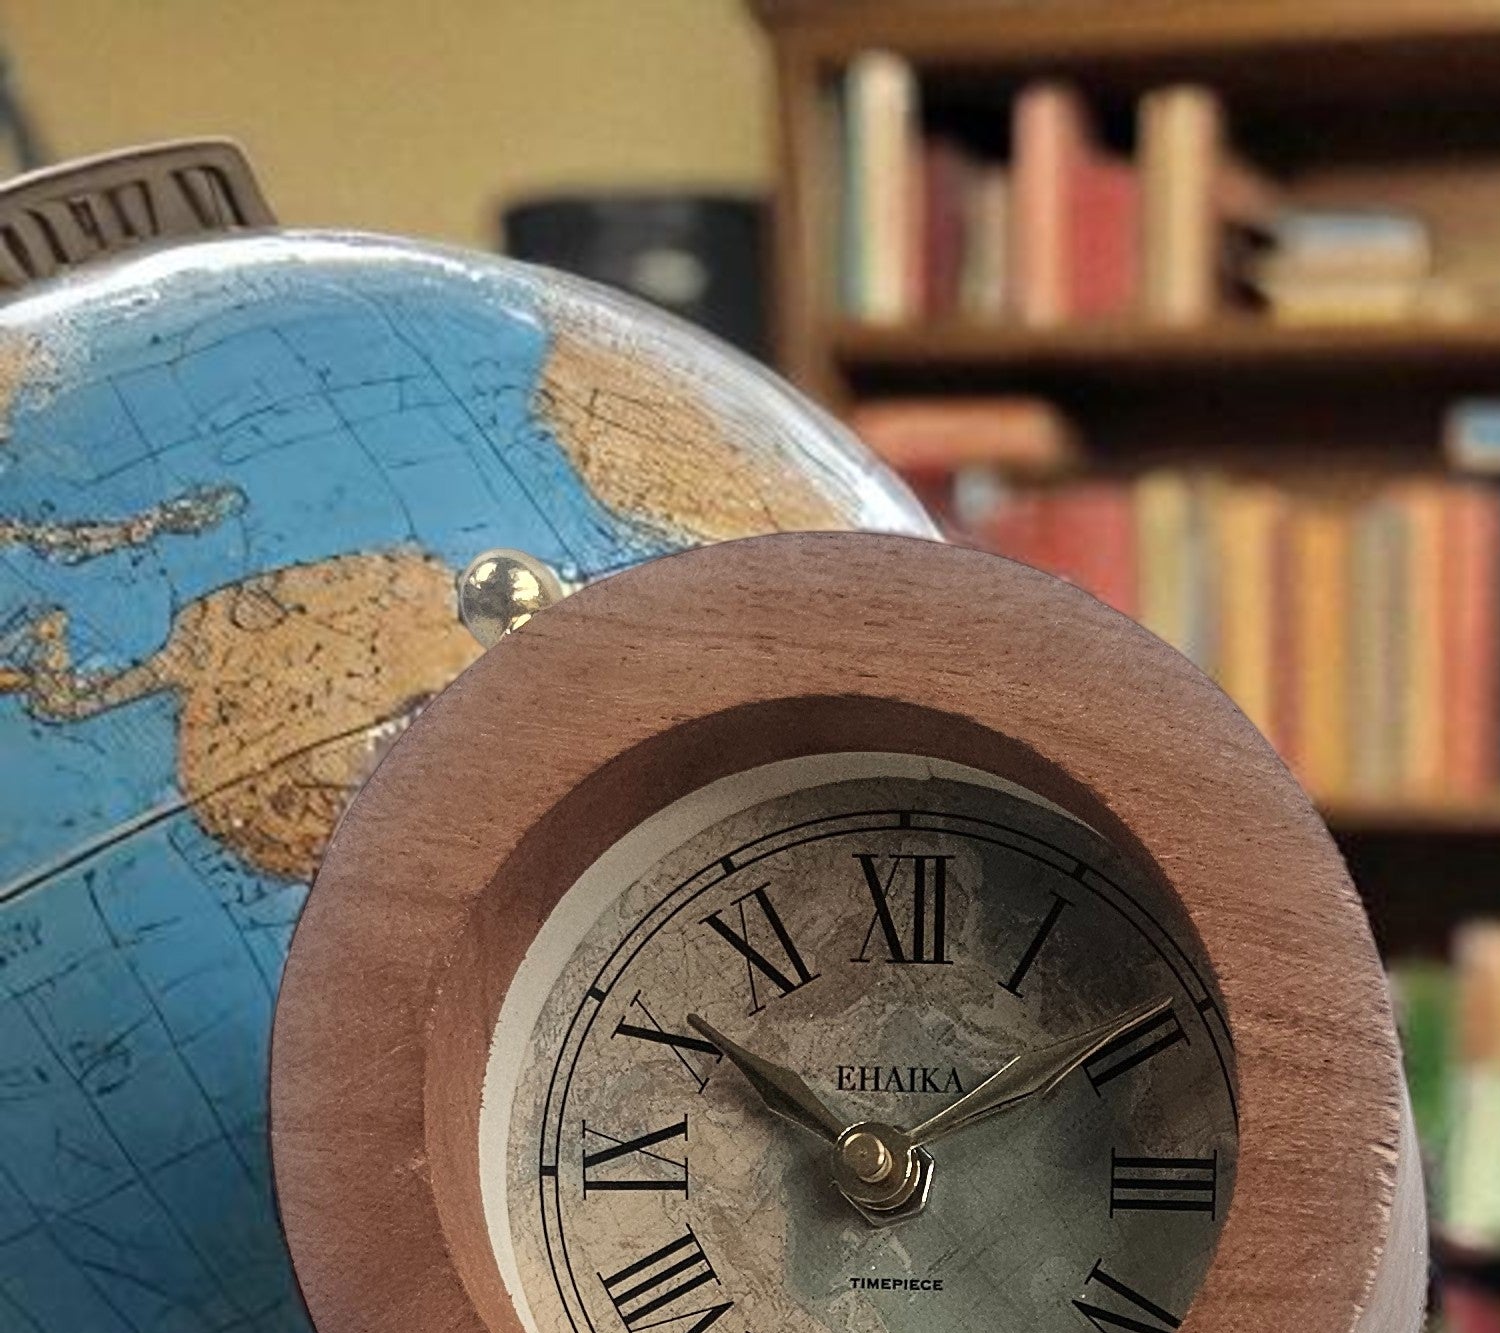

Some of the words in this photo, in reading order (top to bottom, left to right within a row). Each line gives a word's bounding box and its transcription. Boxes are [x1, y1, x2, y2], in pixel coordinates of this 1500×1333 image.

[700, 881, 820, 1015] XI
[851, 853, 956, 965] XII
[998, 891, 1075, 998] I
[610, 989, 725, 1095] X
[835, 1064, 966, 1094] EHAIKA
[582, 1113, 690, 1201] IX
[1109, 1147, 1218, 1222] III
[849, 1277, 944, 1291] TIMEPIECE
